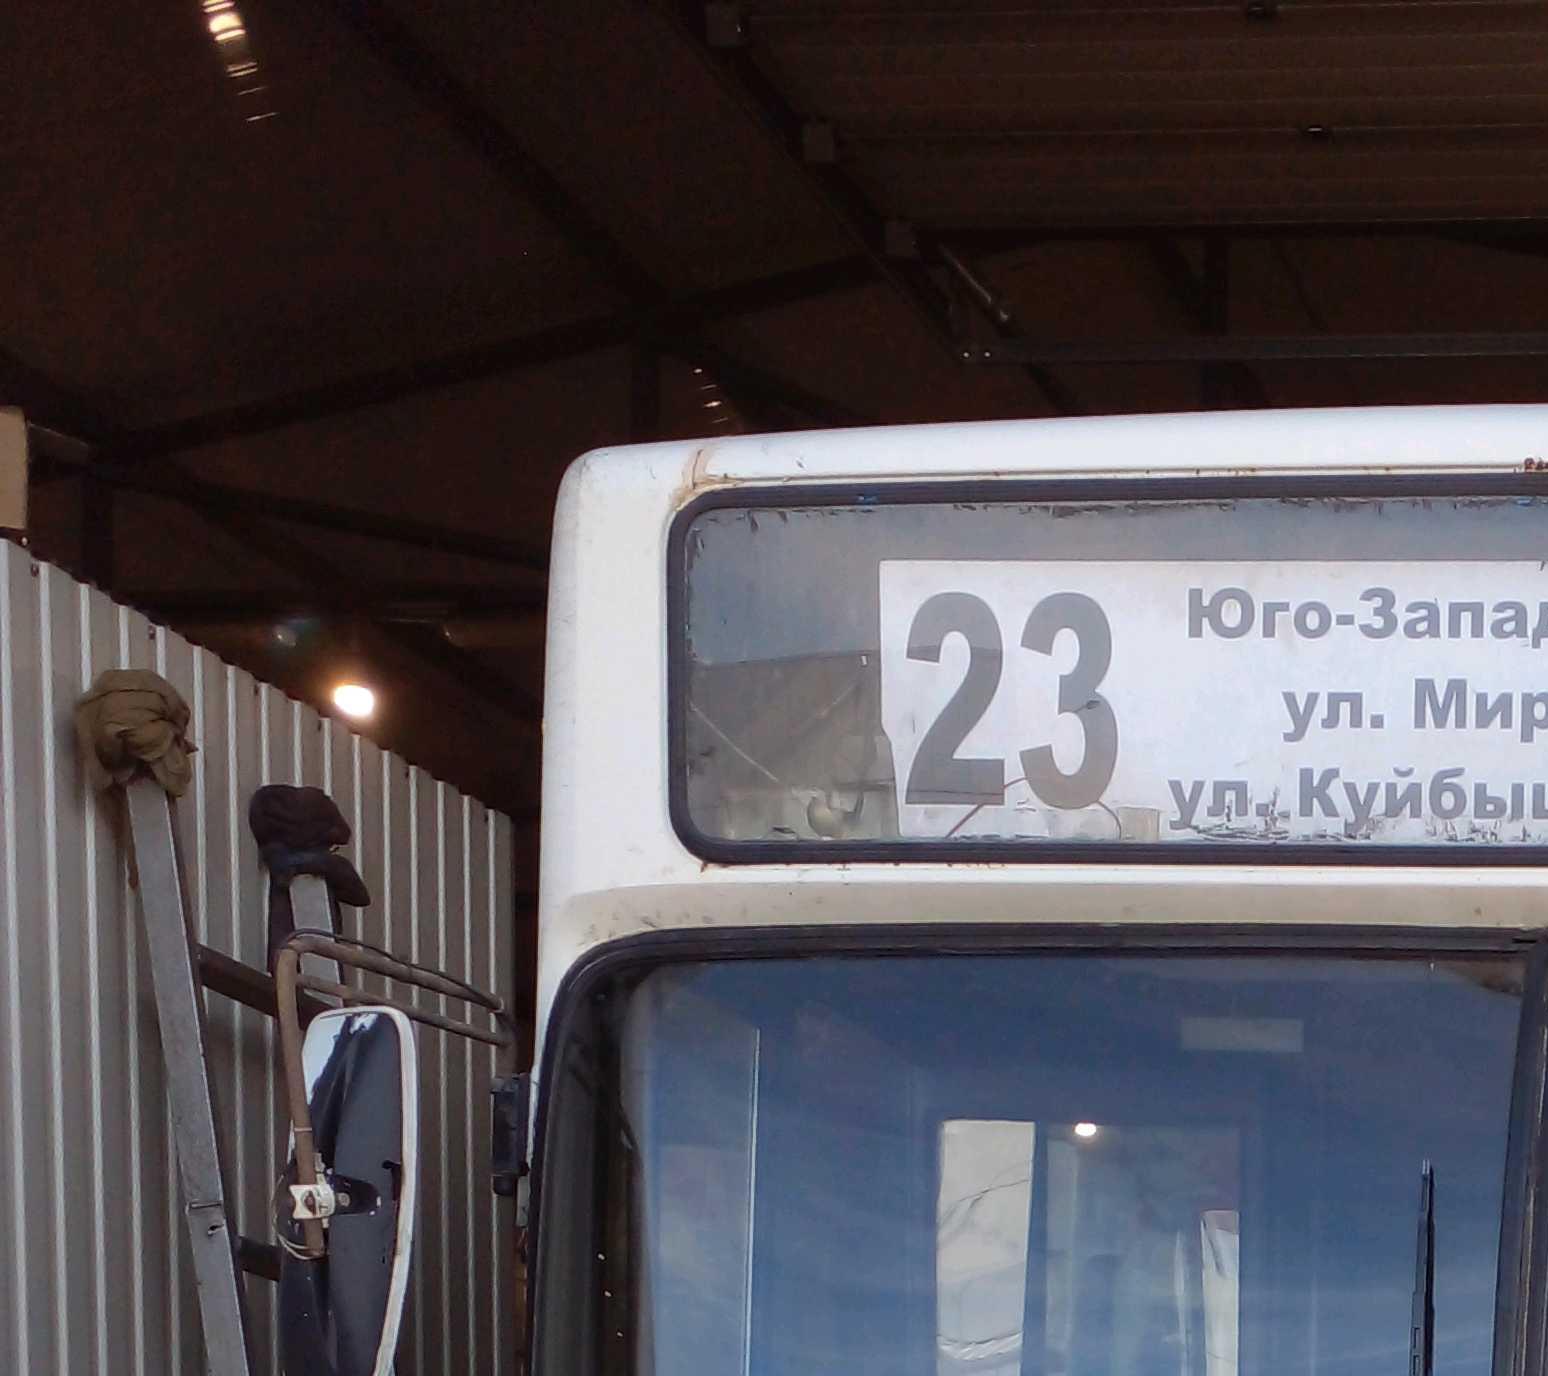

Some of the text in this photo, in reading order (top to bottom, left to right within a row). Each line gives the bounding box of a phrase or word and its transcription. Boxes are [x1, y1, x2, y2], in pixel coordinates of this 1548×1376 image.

[904, 591, 1119, 810] 23
[1282, 690, 1383, 742] ул.
[1168, 779, 1271, 831] ул.
